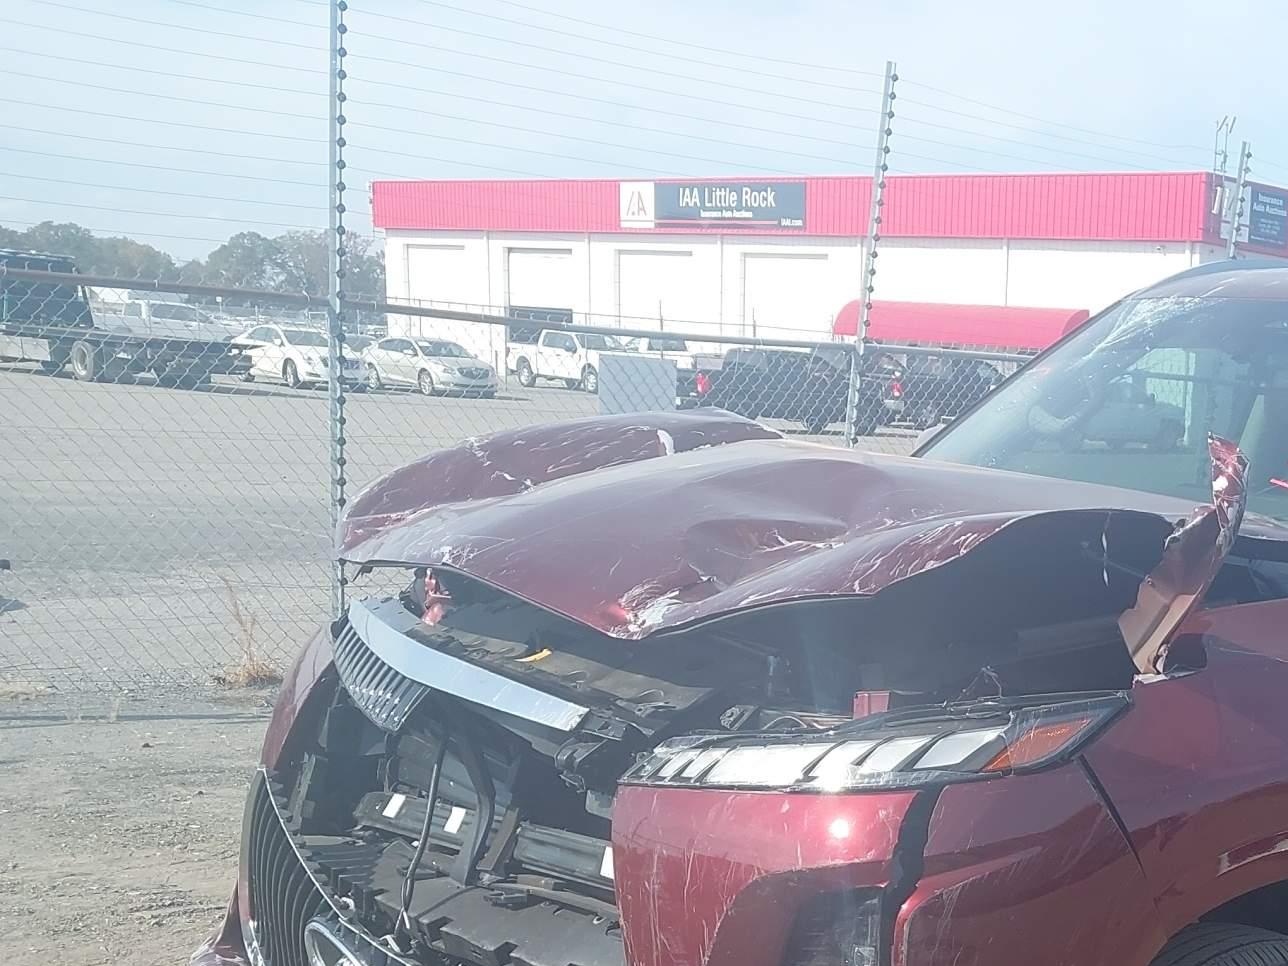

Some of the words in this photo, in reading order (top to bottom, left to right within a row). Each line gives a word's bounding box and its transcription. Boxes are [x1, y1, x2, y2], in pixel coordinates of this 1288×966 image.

[679, 187, 700, 208] IAA
[704, 186, 738, 208] Little
[742, 187, 776, 208] Rock
